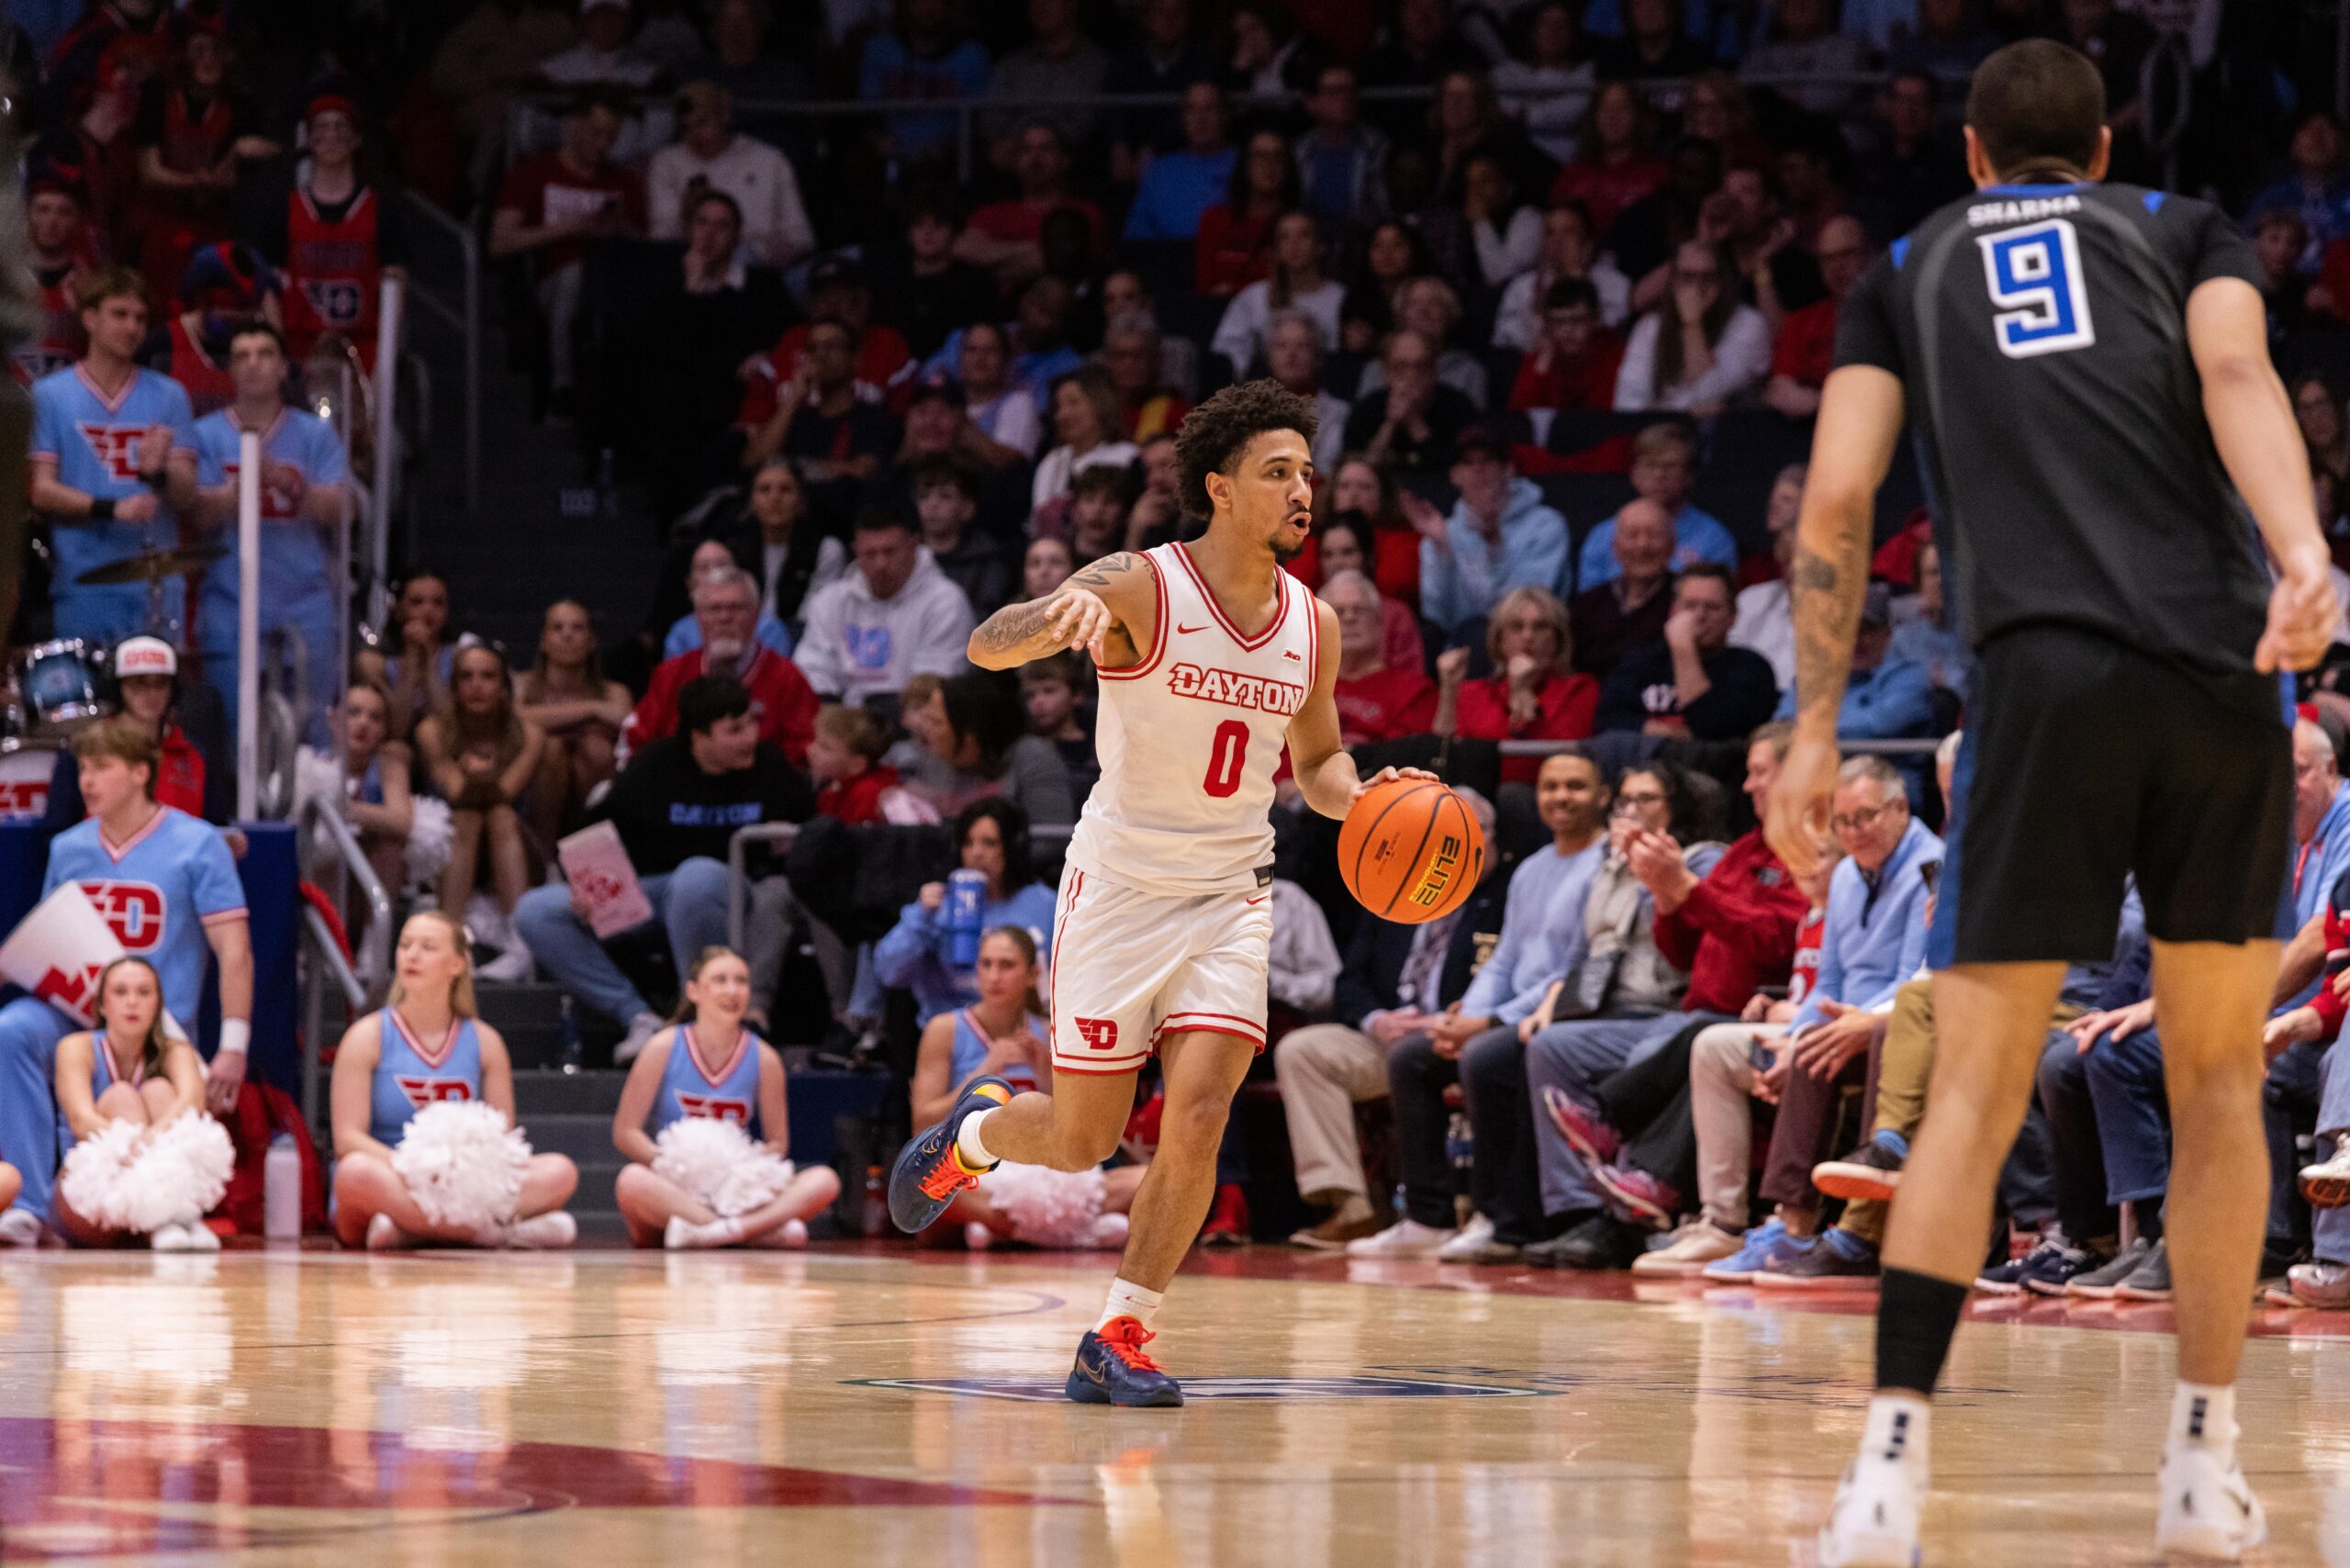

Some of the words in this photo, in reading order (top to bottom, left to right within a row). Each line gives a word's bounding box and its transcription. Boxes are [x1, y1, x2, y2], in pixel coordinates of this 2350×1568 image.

[1967, 195, 2081, 228] SHARMA
[1975, 218, 2096, 359] 9
[1167, 662, 1304, 717] DAYTON
[1203, 720, 1249, 798] 0
[1415, 834, 1461, 907] ELITE
